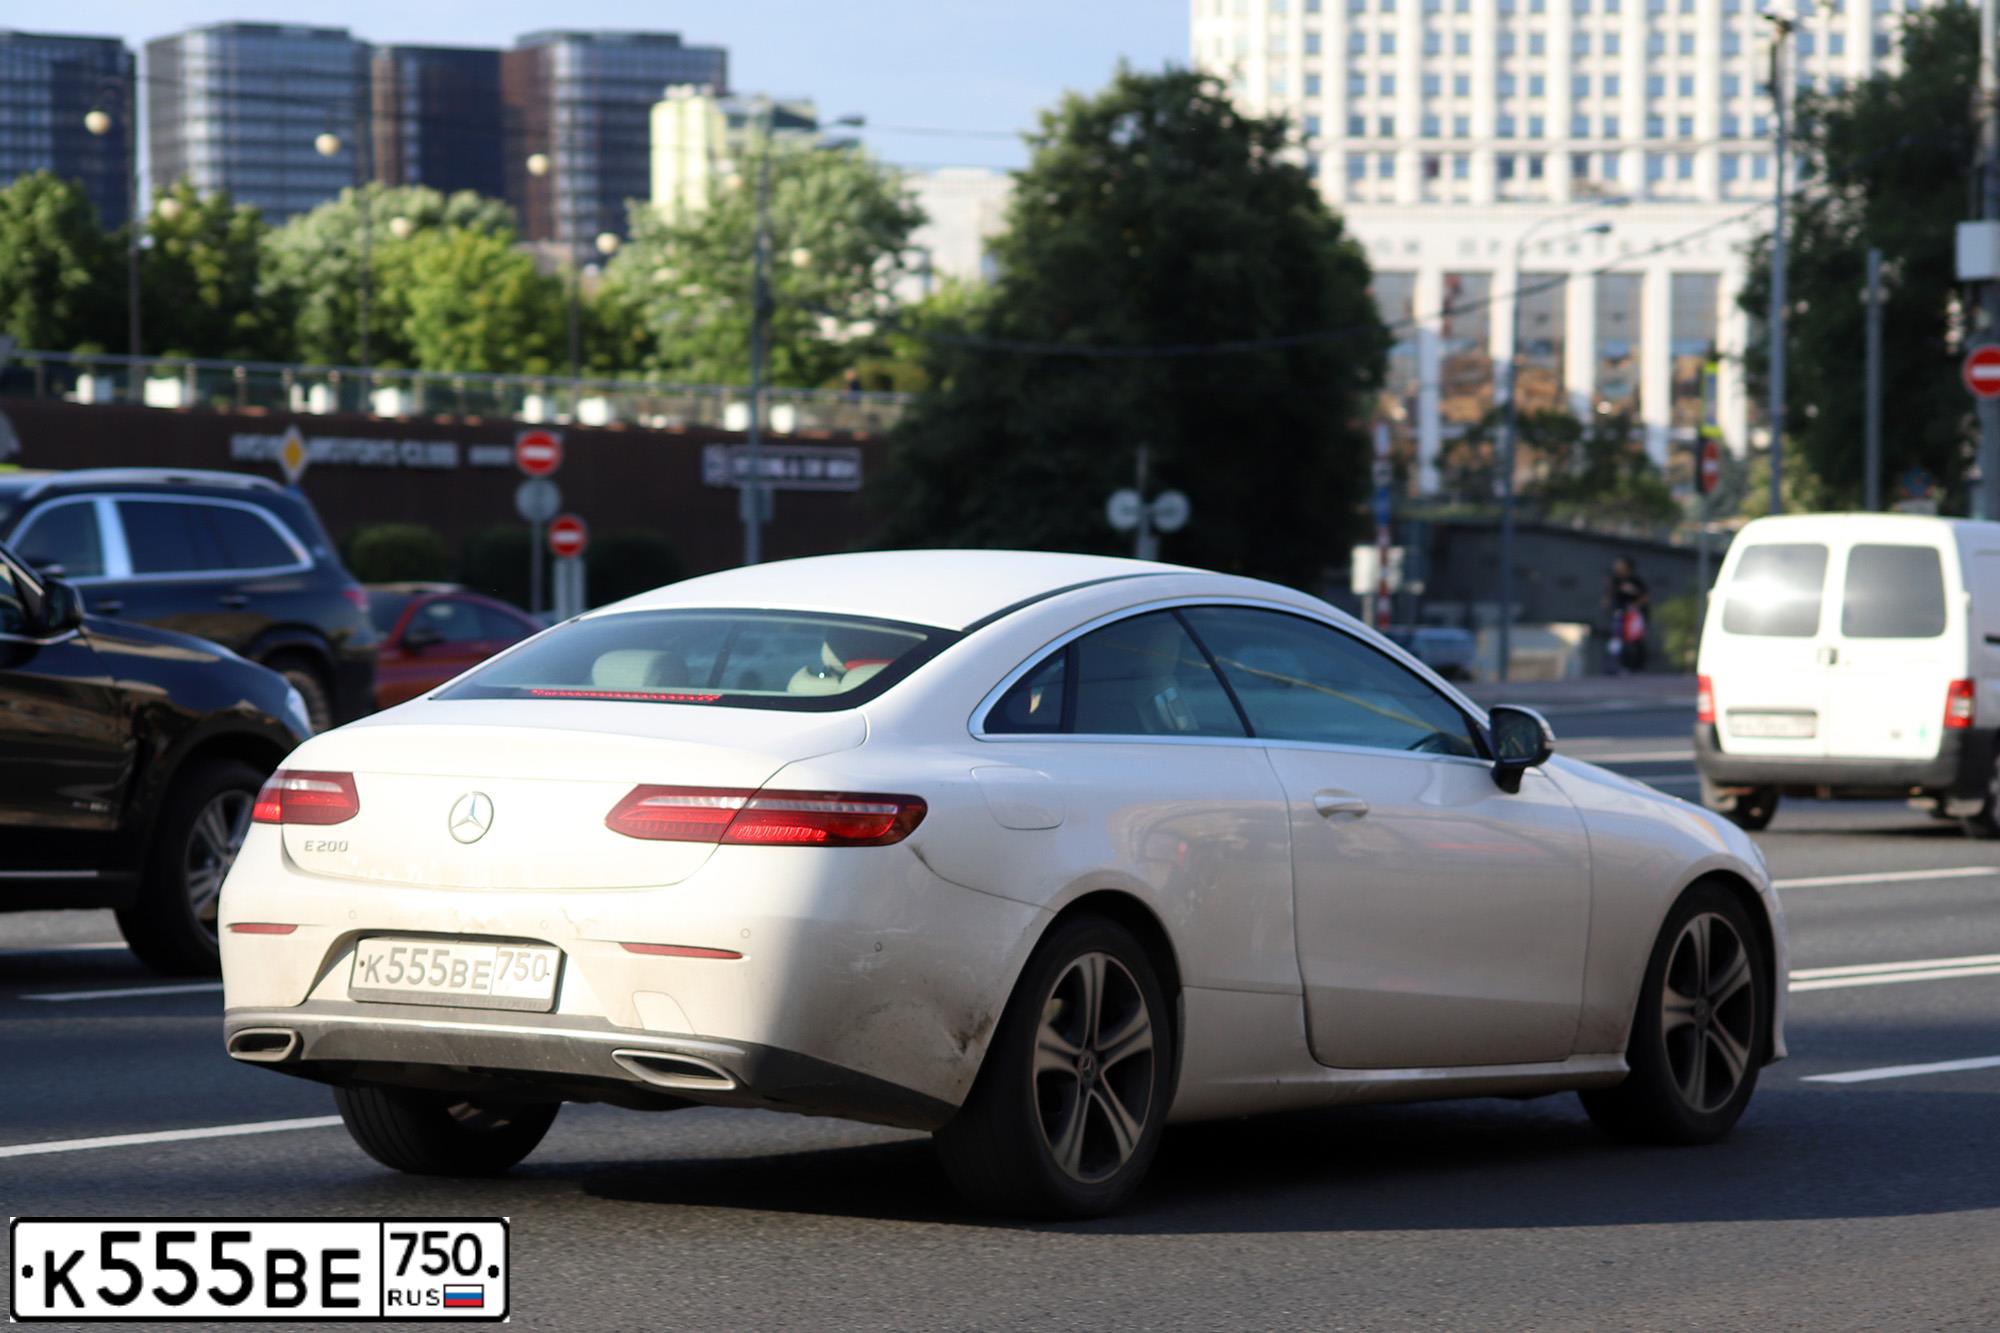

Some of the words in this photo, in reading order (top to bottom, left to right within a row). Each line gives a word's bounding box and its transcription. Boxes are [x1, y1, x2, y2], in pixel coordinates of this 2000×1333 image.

[304, 840, 314, 852] E
[316, 840, 348, 852] 200
[497, 950, 548, 982] 750
